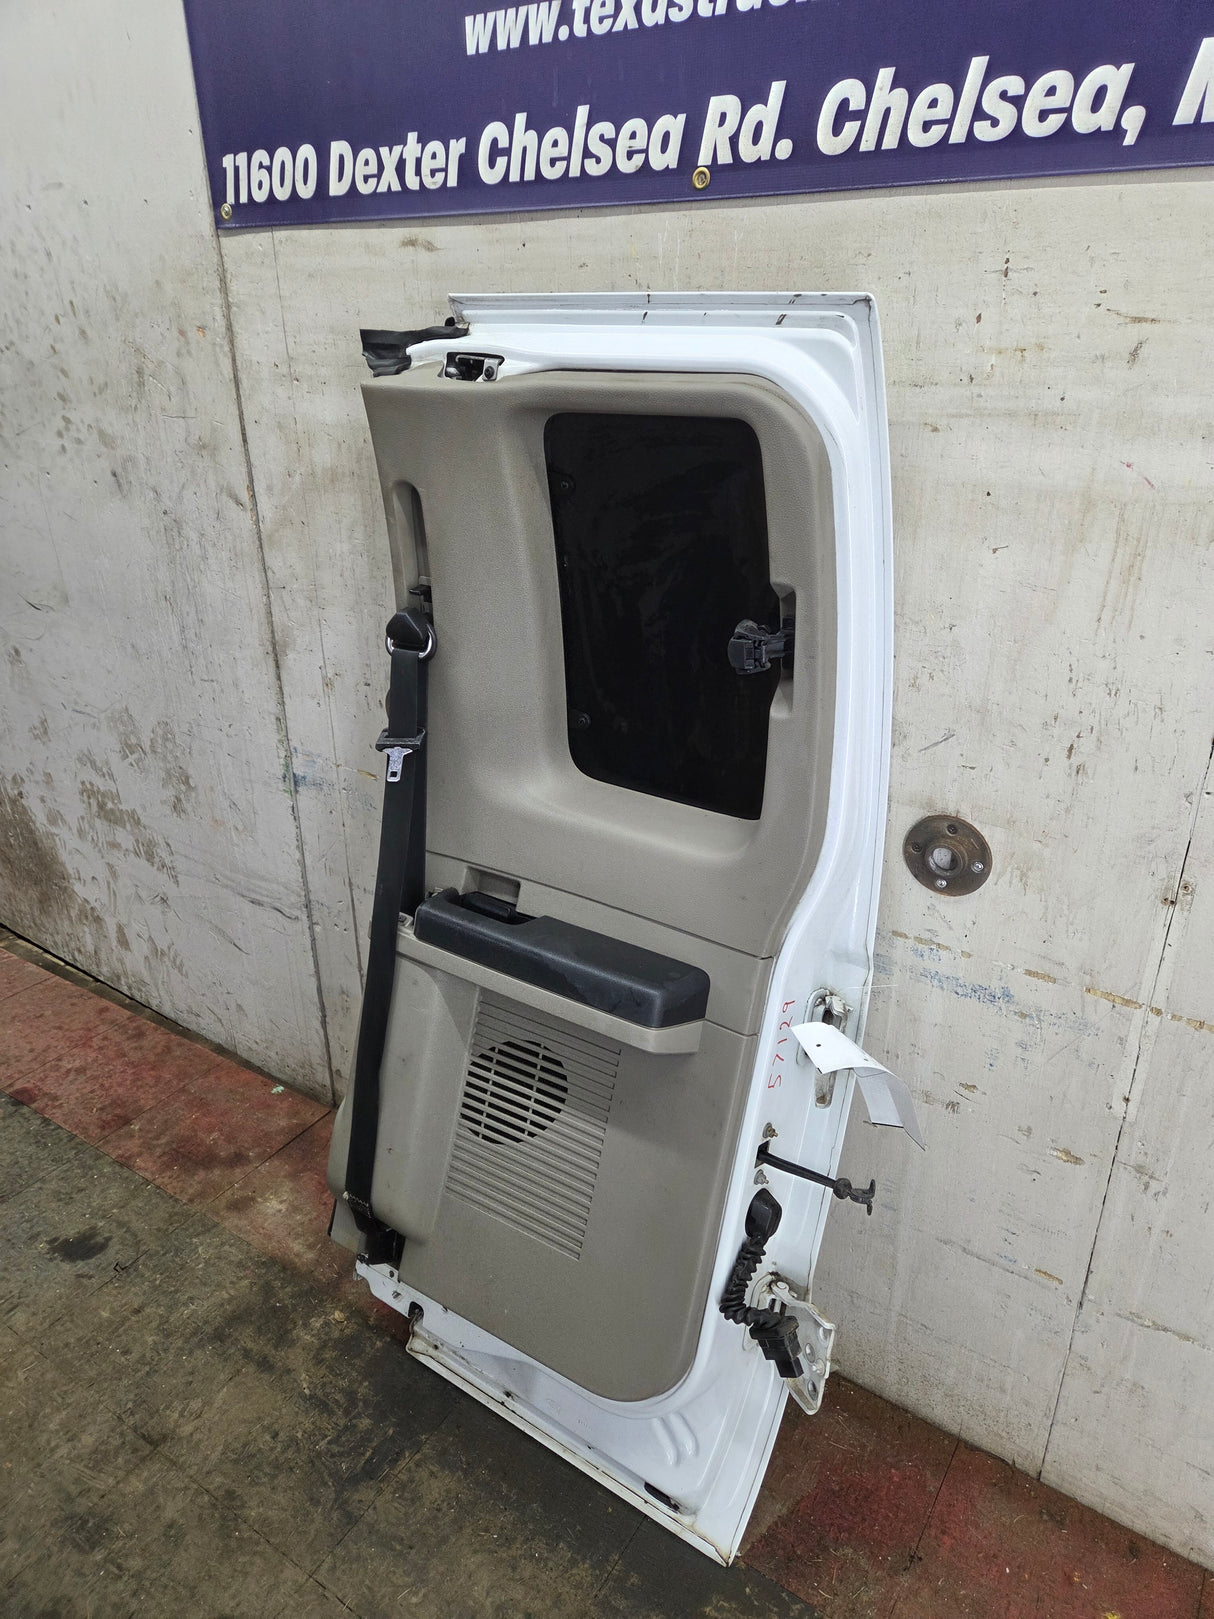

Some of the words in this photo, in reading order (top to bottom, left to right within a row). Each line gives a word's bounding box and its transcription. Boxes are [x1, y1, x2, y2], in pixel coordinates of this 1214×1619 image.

[222, 143, 318, 205] 11600
[328, 131, 467, 197] Dexter
[477, 104, 687, 185] Chelsea
[697, 79, 794, 167] Rd.
[816, 55, 1147, 156] Chelsea,
[767, 999, 796, 1089] 57129
